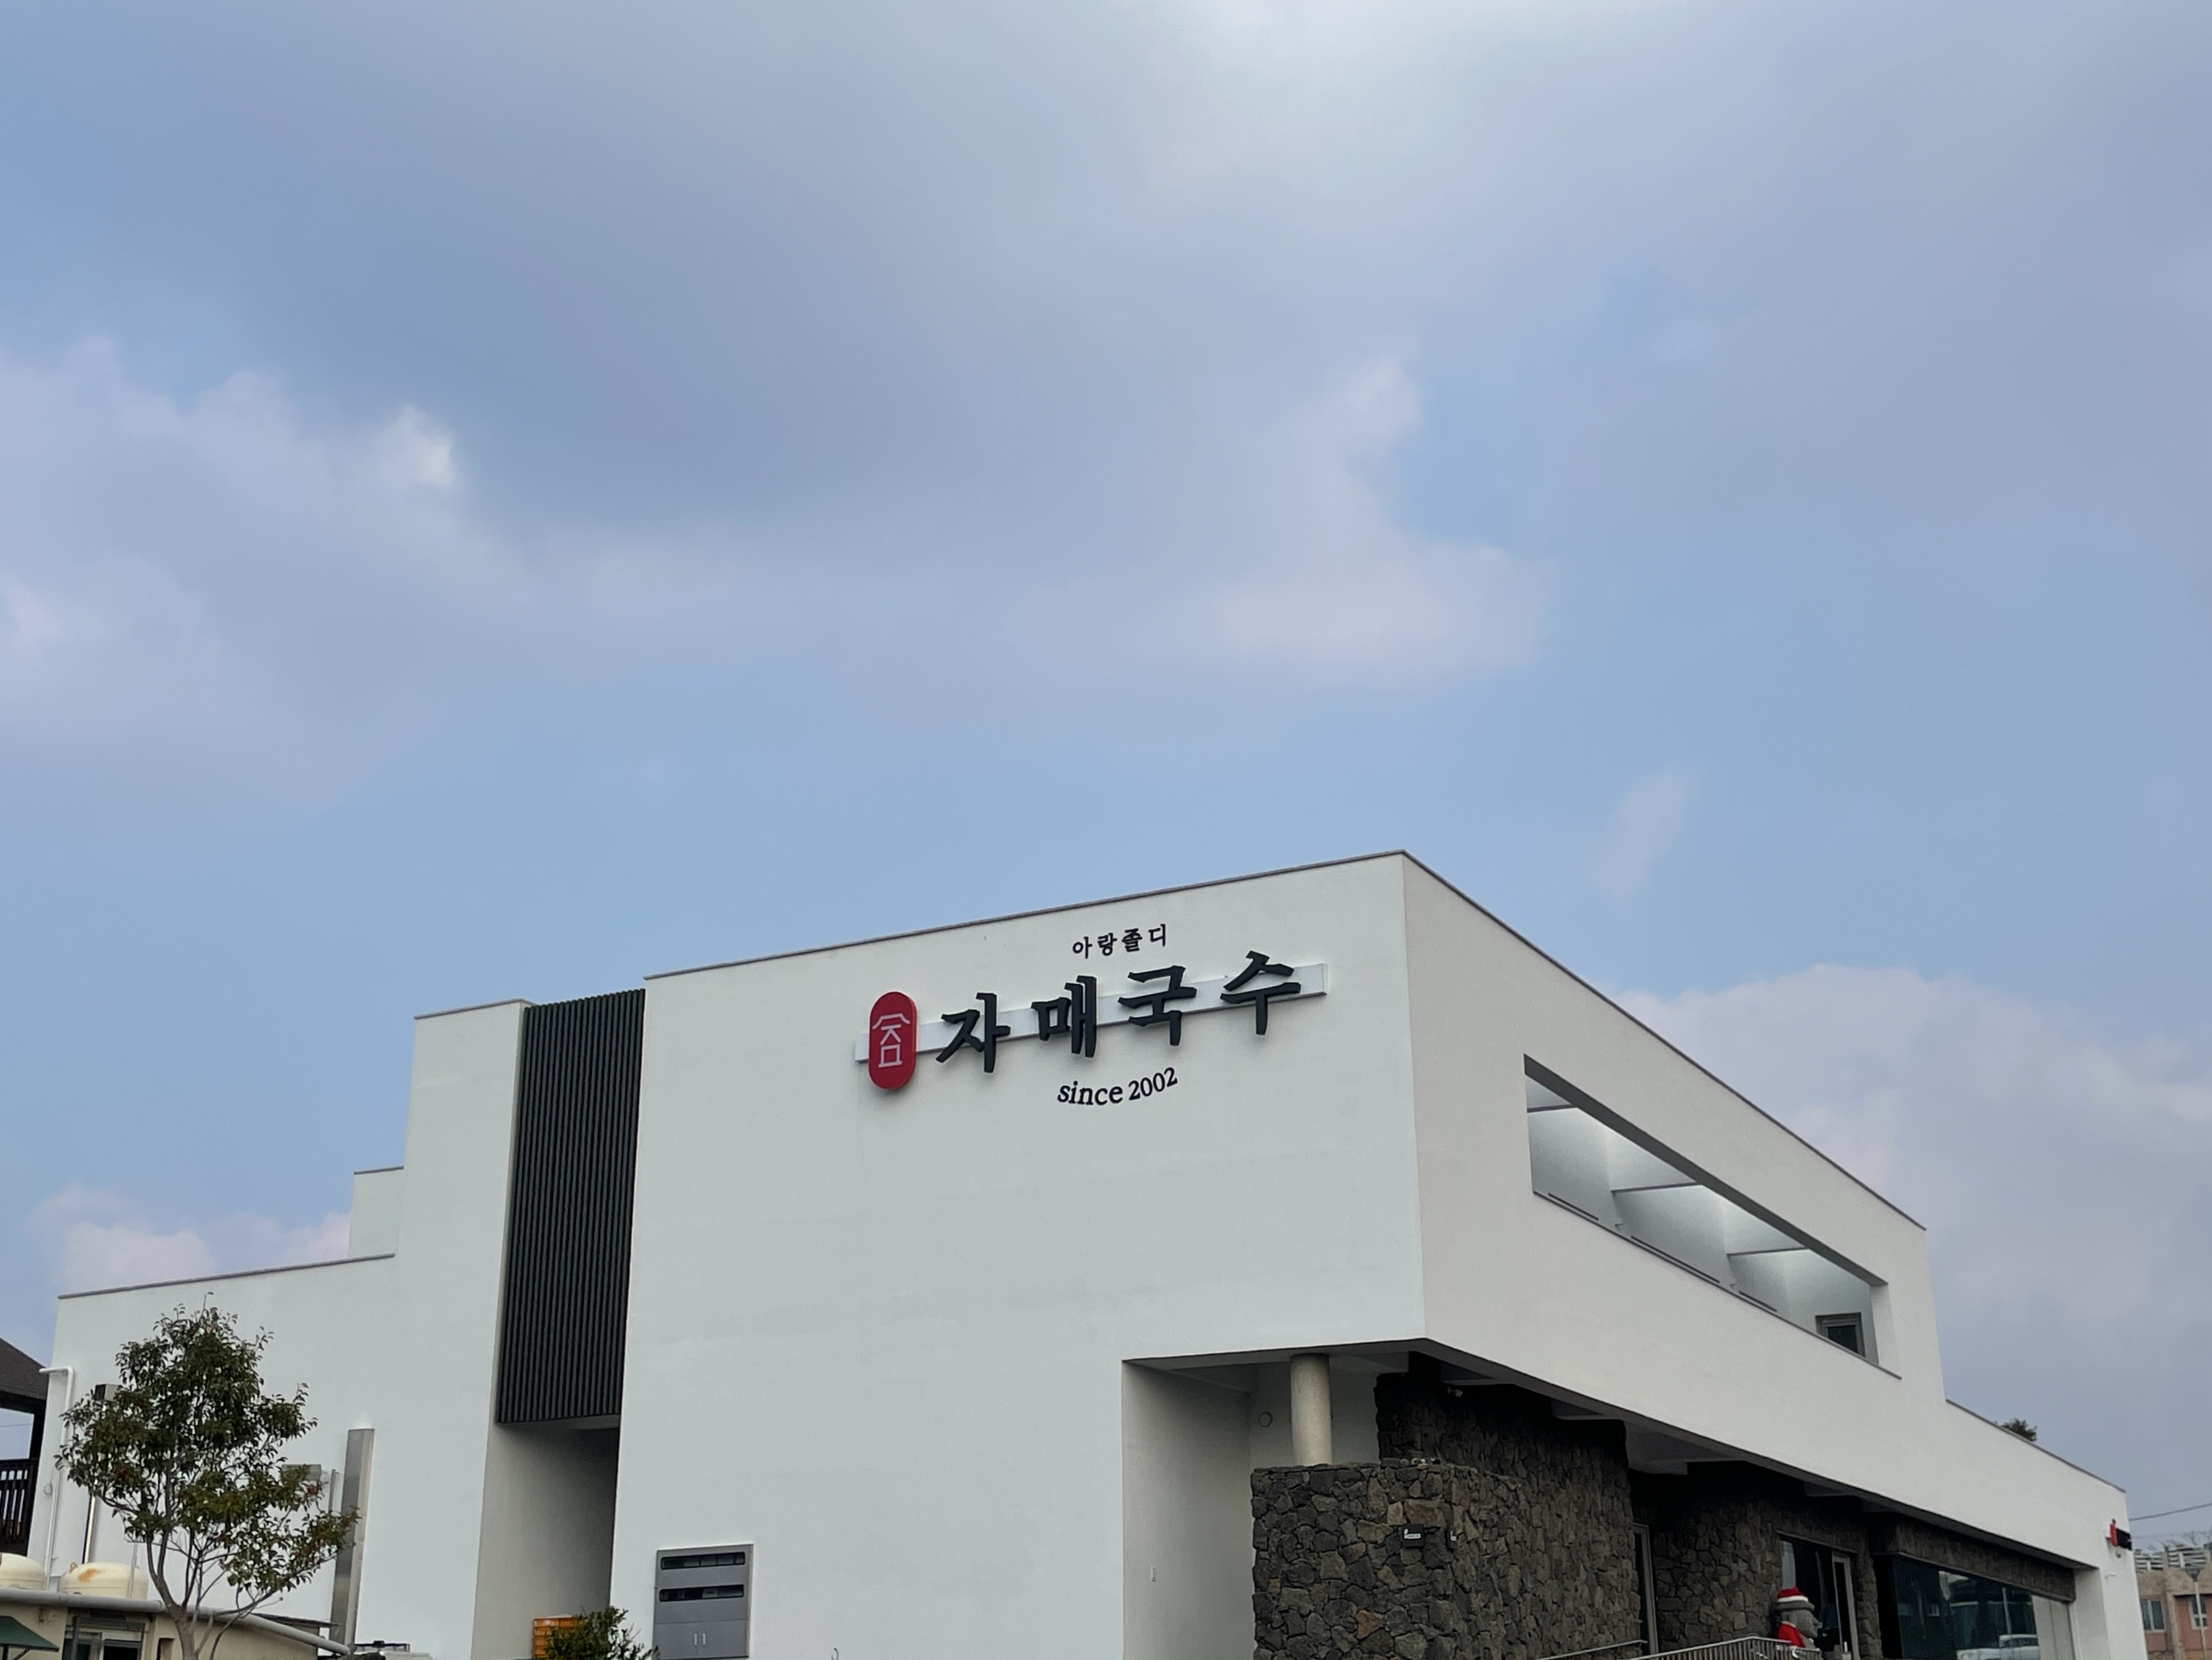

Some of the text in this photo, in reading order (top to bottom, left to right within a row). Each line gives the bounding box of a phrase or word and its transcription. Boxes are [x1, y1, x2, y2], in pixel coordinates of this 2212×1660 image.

[1072, 924, 1166, 959] 아랑졸디
[935, 950, 1301, 1073] 자매국수
[1057, 1067, 1178, 1106] since 2002
